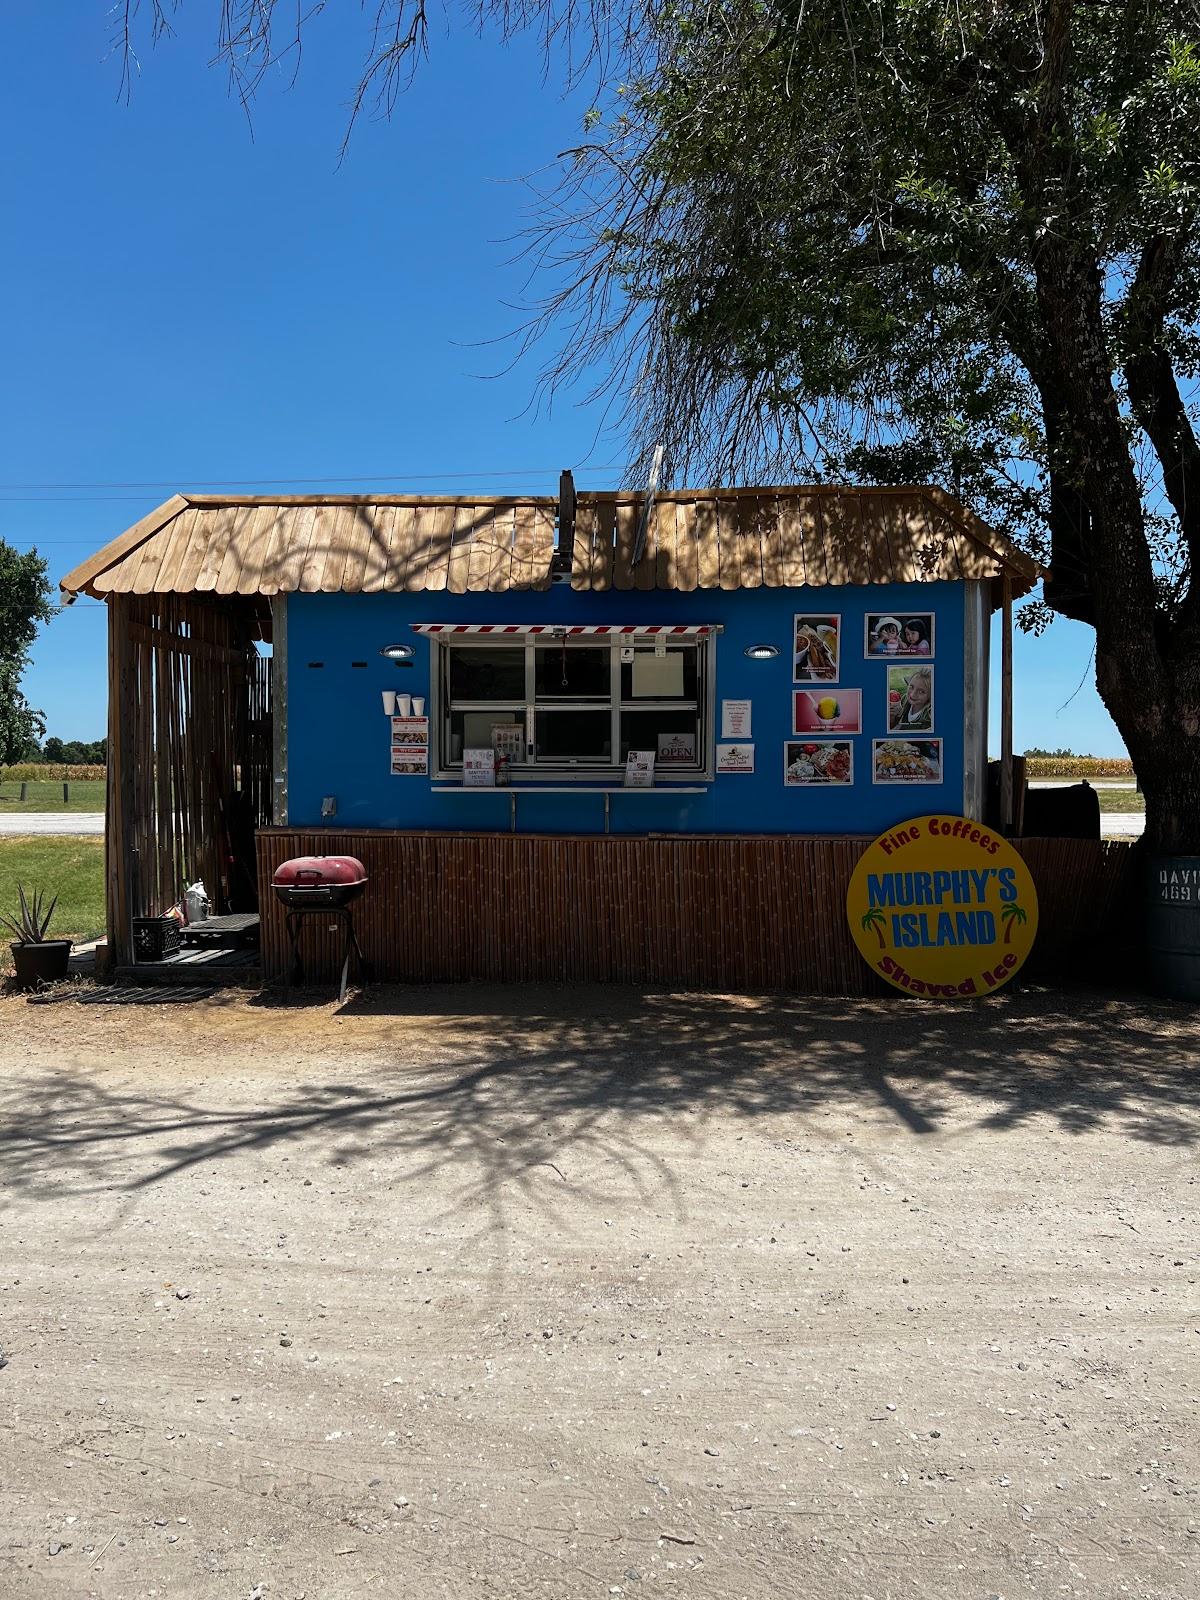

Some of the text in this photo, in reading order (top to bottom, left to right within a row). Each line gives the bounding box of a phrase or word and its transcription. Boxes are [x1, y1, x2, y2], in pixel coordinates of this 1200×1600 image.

[661, 747, 692, 756] OPEN
[879, 818, 1001, 855] Fine Coffees
[867, 867, 1018, 907] MURPHY'S
[891, 910, 997, 948] ISLAND
[877, 953, 1018, 997] Shaved Ice
